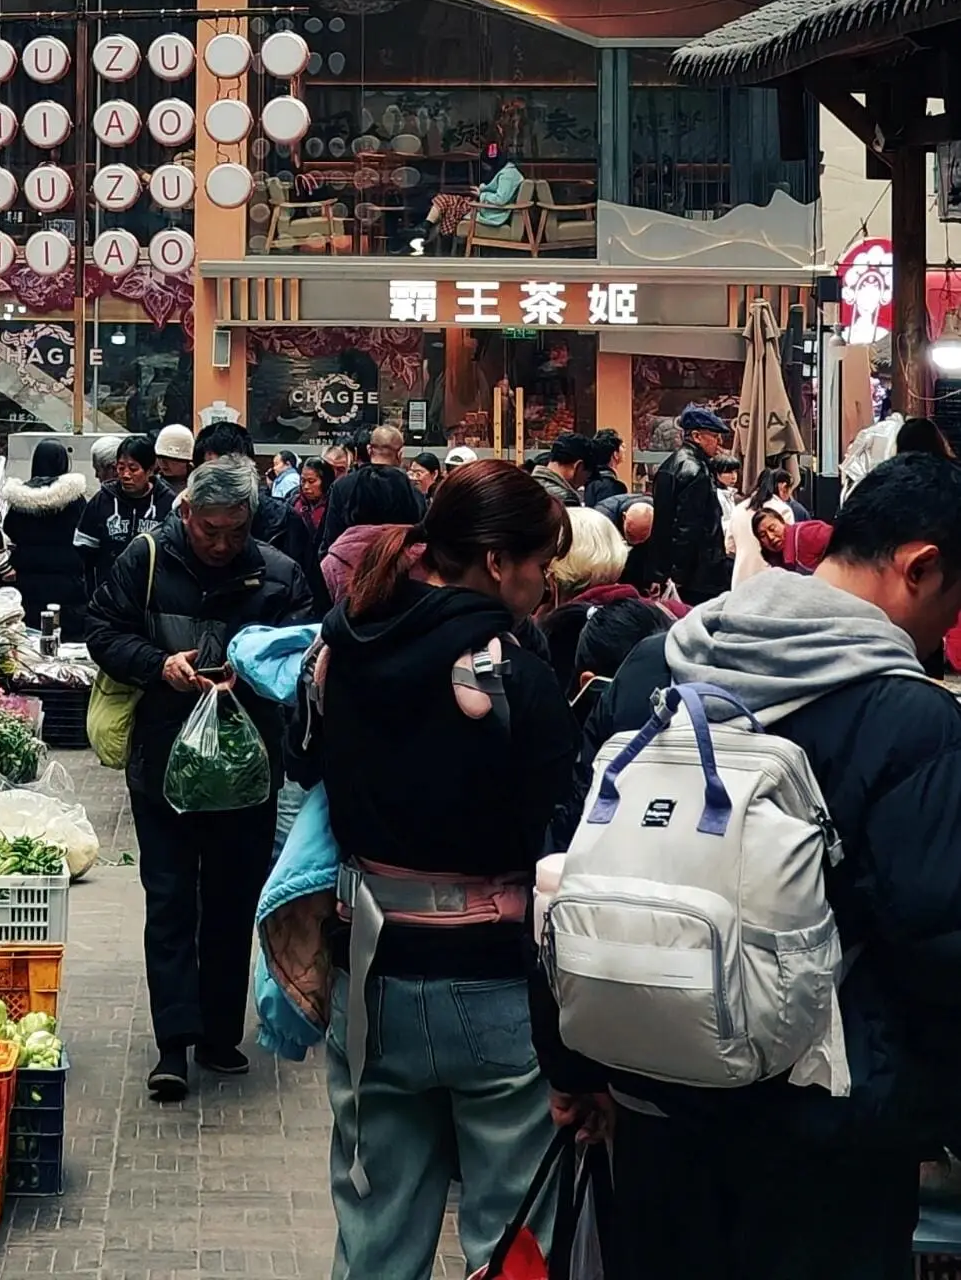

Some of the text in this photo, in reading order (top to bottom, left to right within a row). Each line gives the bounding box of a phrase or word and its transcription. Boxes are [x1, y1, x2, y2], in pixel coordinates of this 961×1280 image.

[389, 280, 638, 325] 霸王茶姬
[291, 390, 379, 405] CHAGEE
